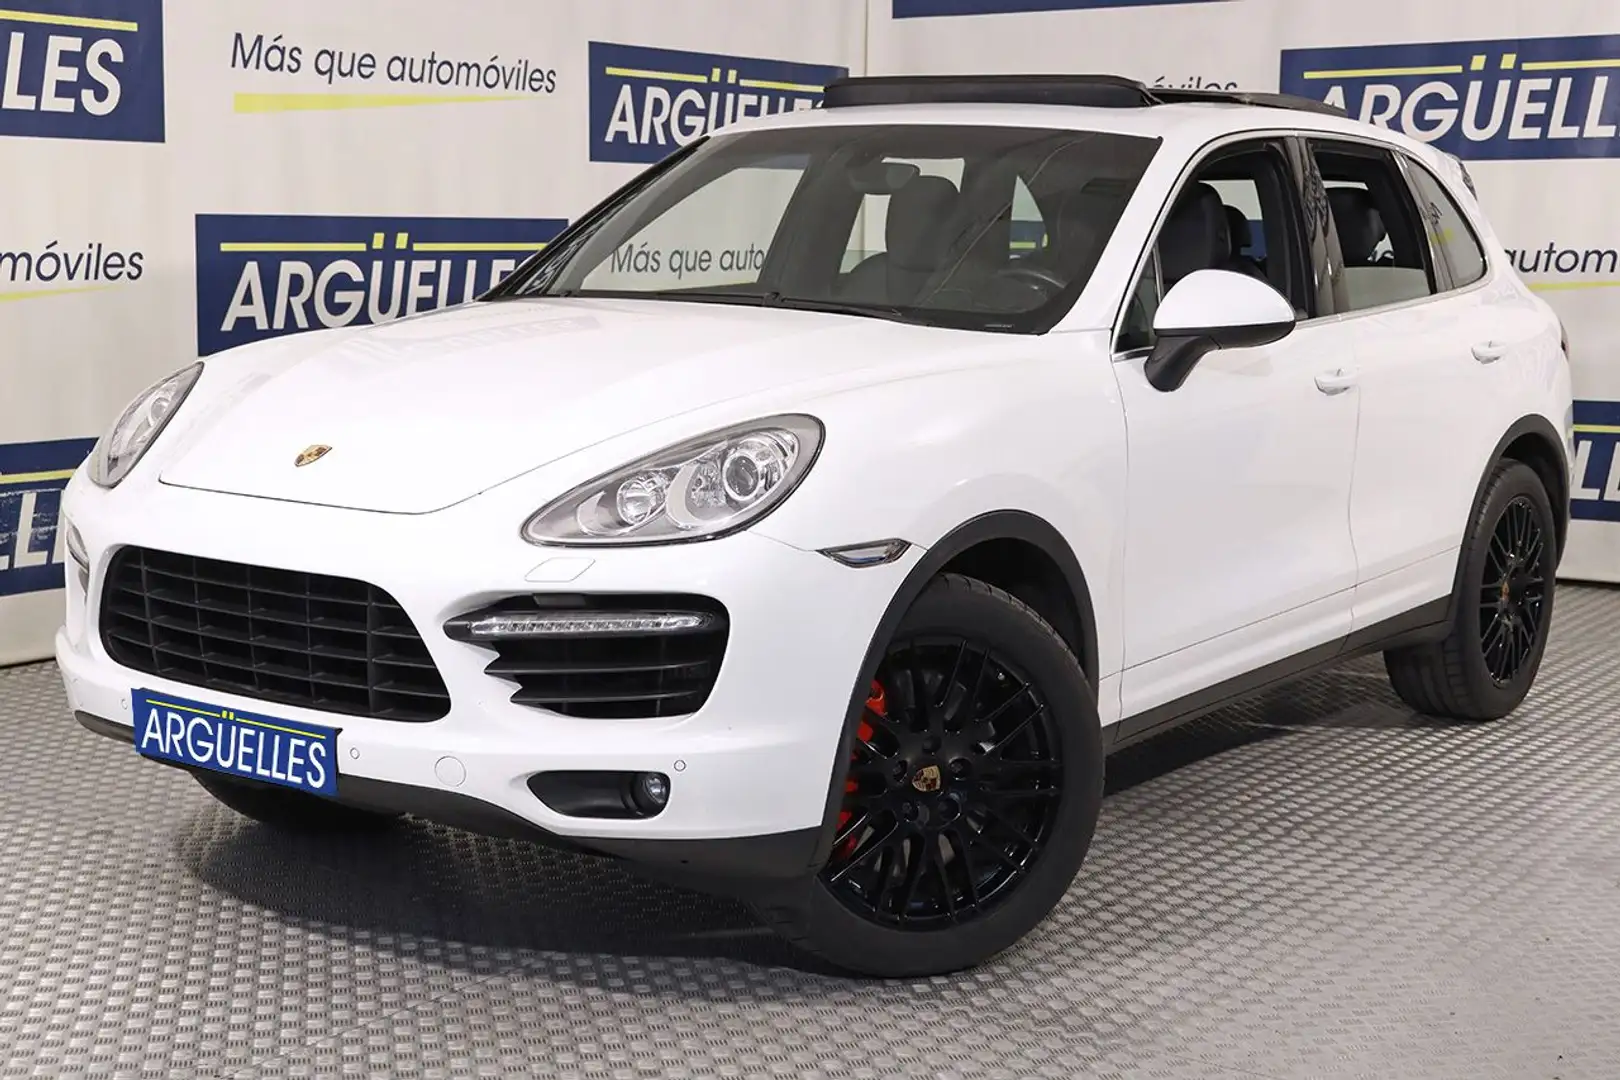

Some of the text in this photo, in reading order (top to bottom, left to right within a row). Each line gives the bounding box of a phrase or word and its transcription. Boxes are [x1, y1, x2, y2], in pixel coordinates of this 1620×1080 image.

[231, 32, 556, 93] Más que automóviles
[611, 242, 661, 273] Más
[668, 249, 712, 280] que
[141, 708, 326, 789] ARGÜELLES
